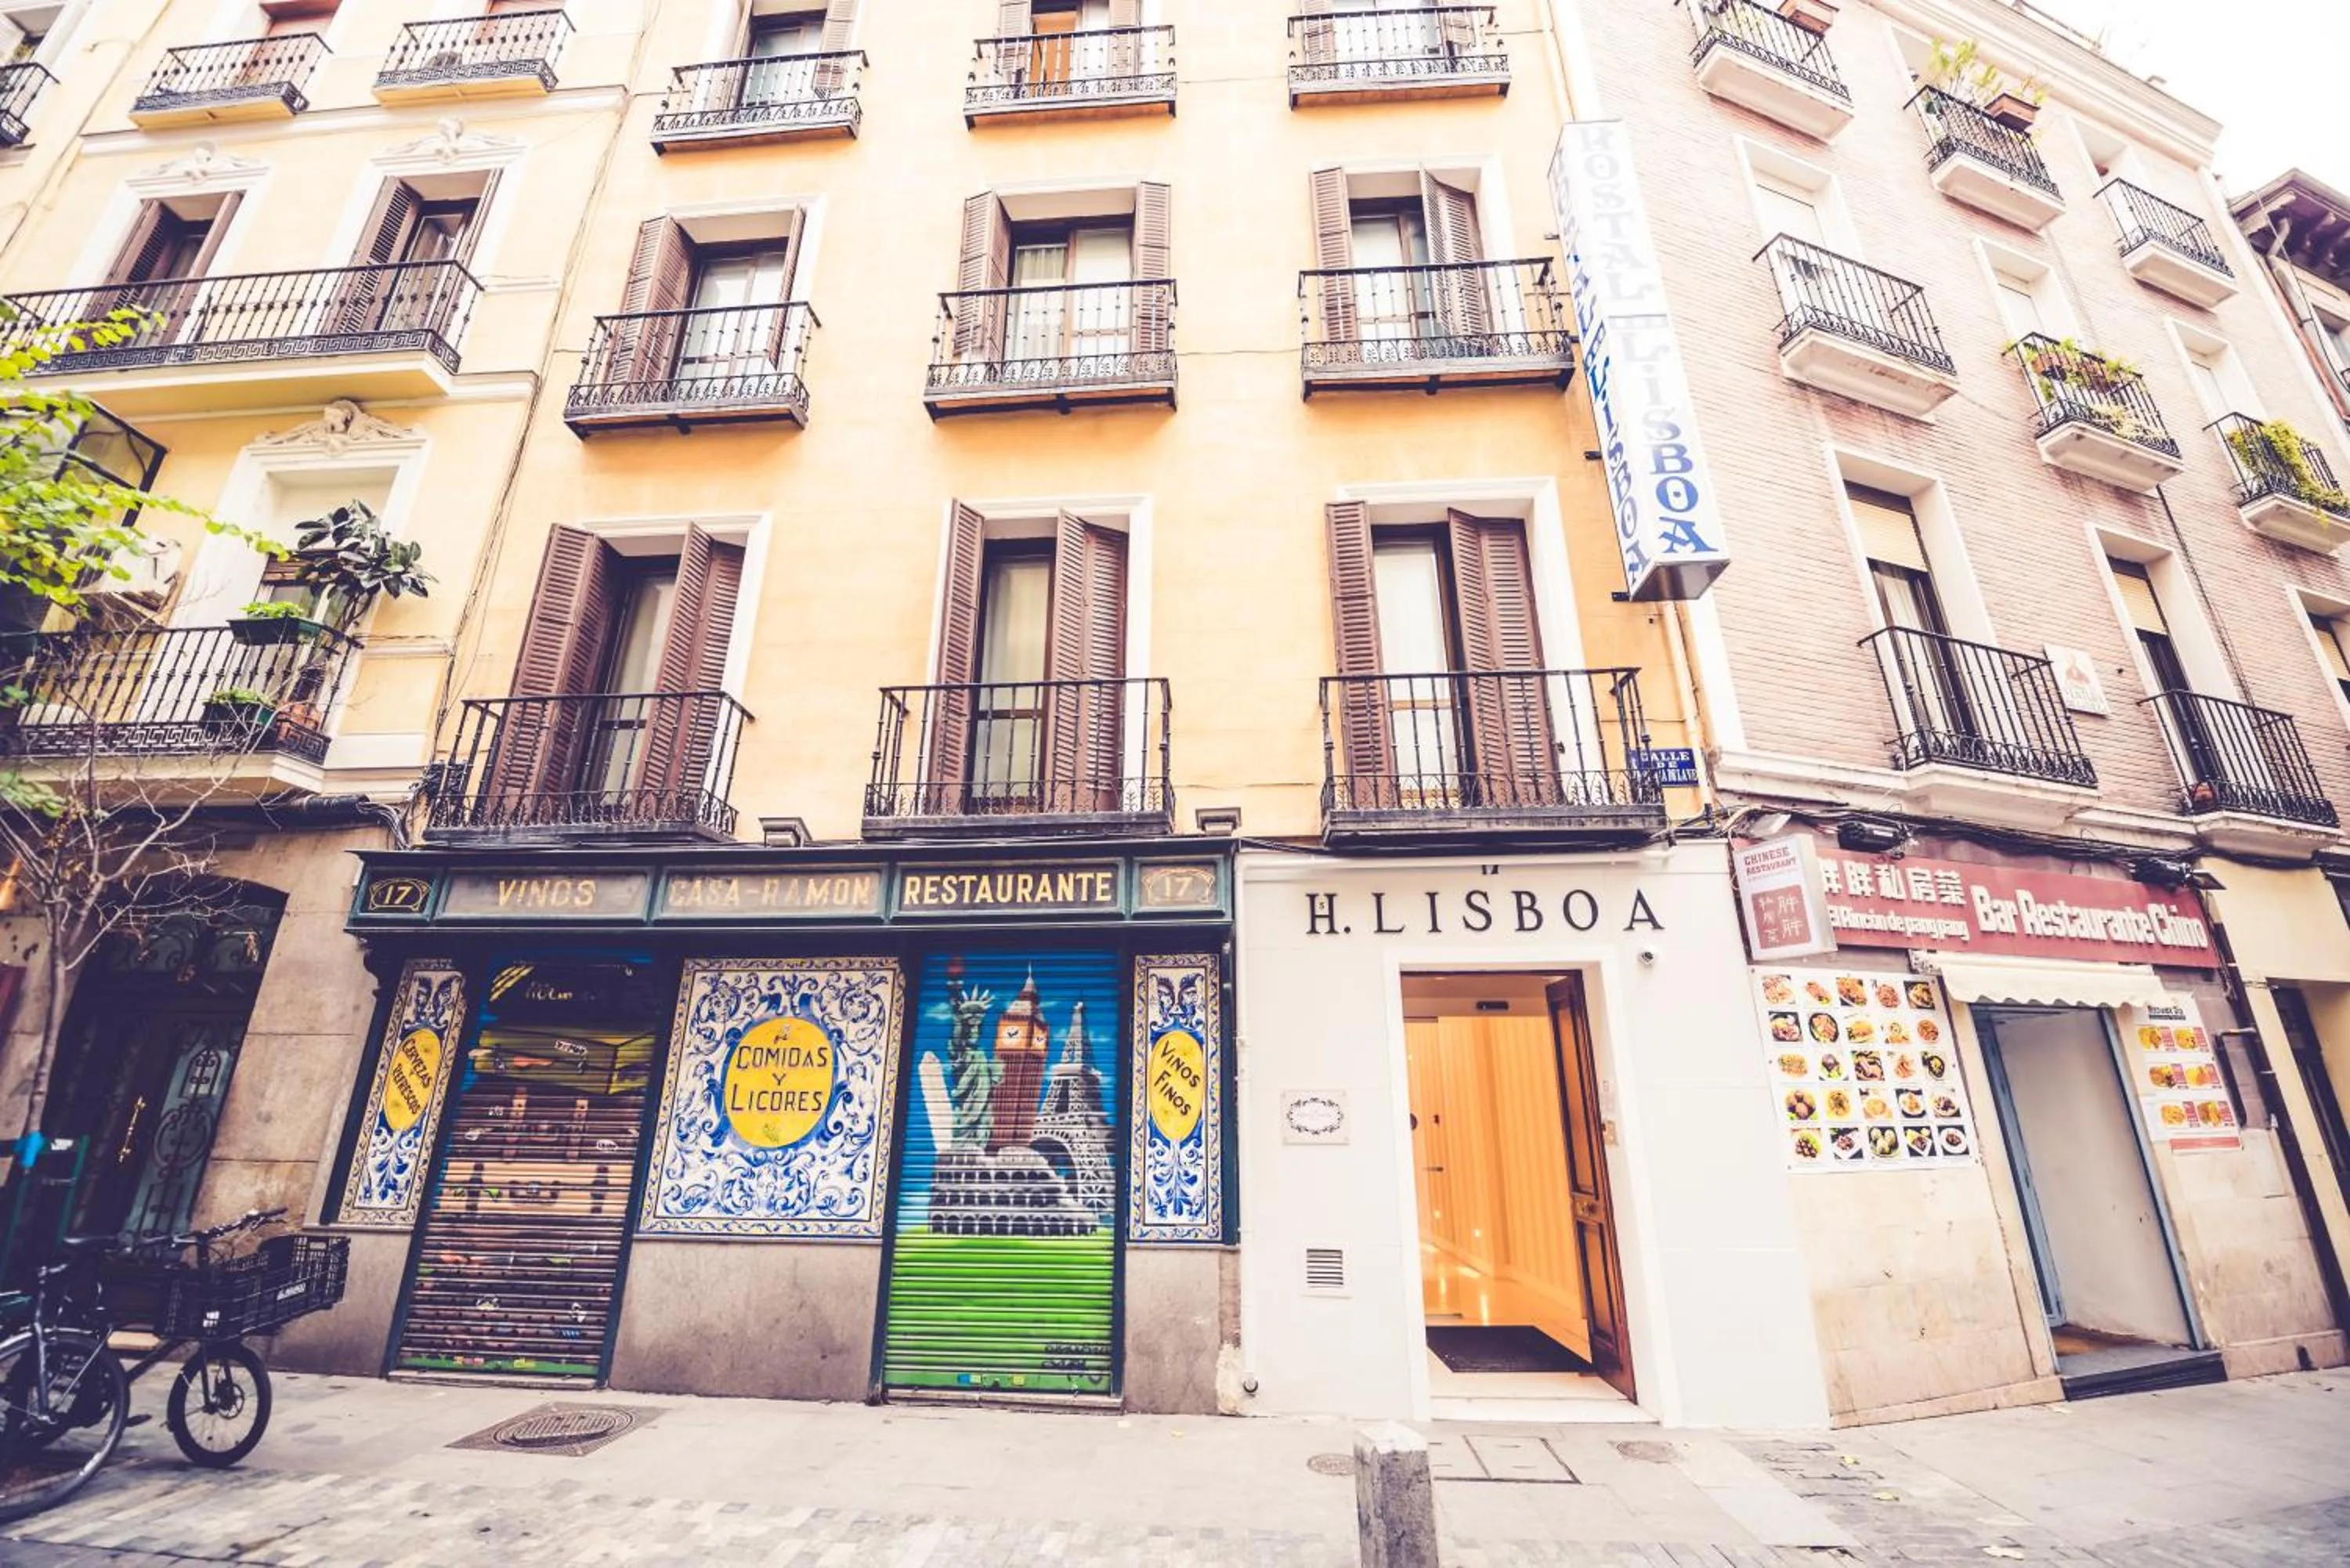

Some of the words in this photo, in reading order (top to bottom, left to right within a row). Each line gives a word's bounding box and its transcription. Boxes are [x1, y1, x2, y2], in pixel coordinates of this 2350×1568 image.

[1622, 334, 1719, 553] LISBOA
[1744, 847, 1791, 865] CHINESE
[1746, 856, 1797, 876] RESTAURANT
[382, 883, 410, 905] 17
[497, 879, 597, 908] VINOS
[903, 871, 1112, 905] RESTAURANTE
[1163, 876, 1191, 898] 17
[1305, 892, 1352, 934] H.
[1371, 889, 1665, 934] LISBOA
[1970, 885, 2018, 934] Bar
[2016, 889, 2155, 944] Restaurante
[2147, 903, 2208, 949] Chino
[402, 1038, 433, 1089] CERVEZAS
[736, 1046, 828, 1070] COMIDAS
[772, 1072, 787, 1086] Y
[1160, 1039, 1202, 1089] VINOS
[392, 1063, 421, 1115] REFRESCOS
[731, 1083, 822, 1112] LICORES
[1154, 1069, 1192, 1116] FINOS
